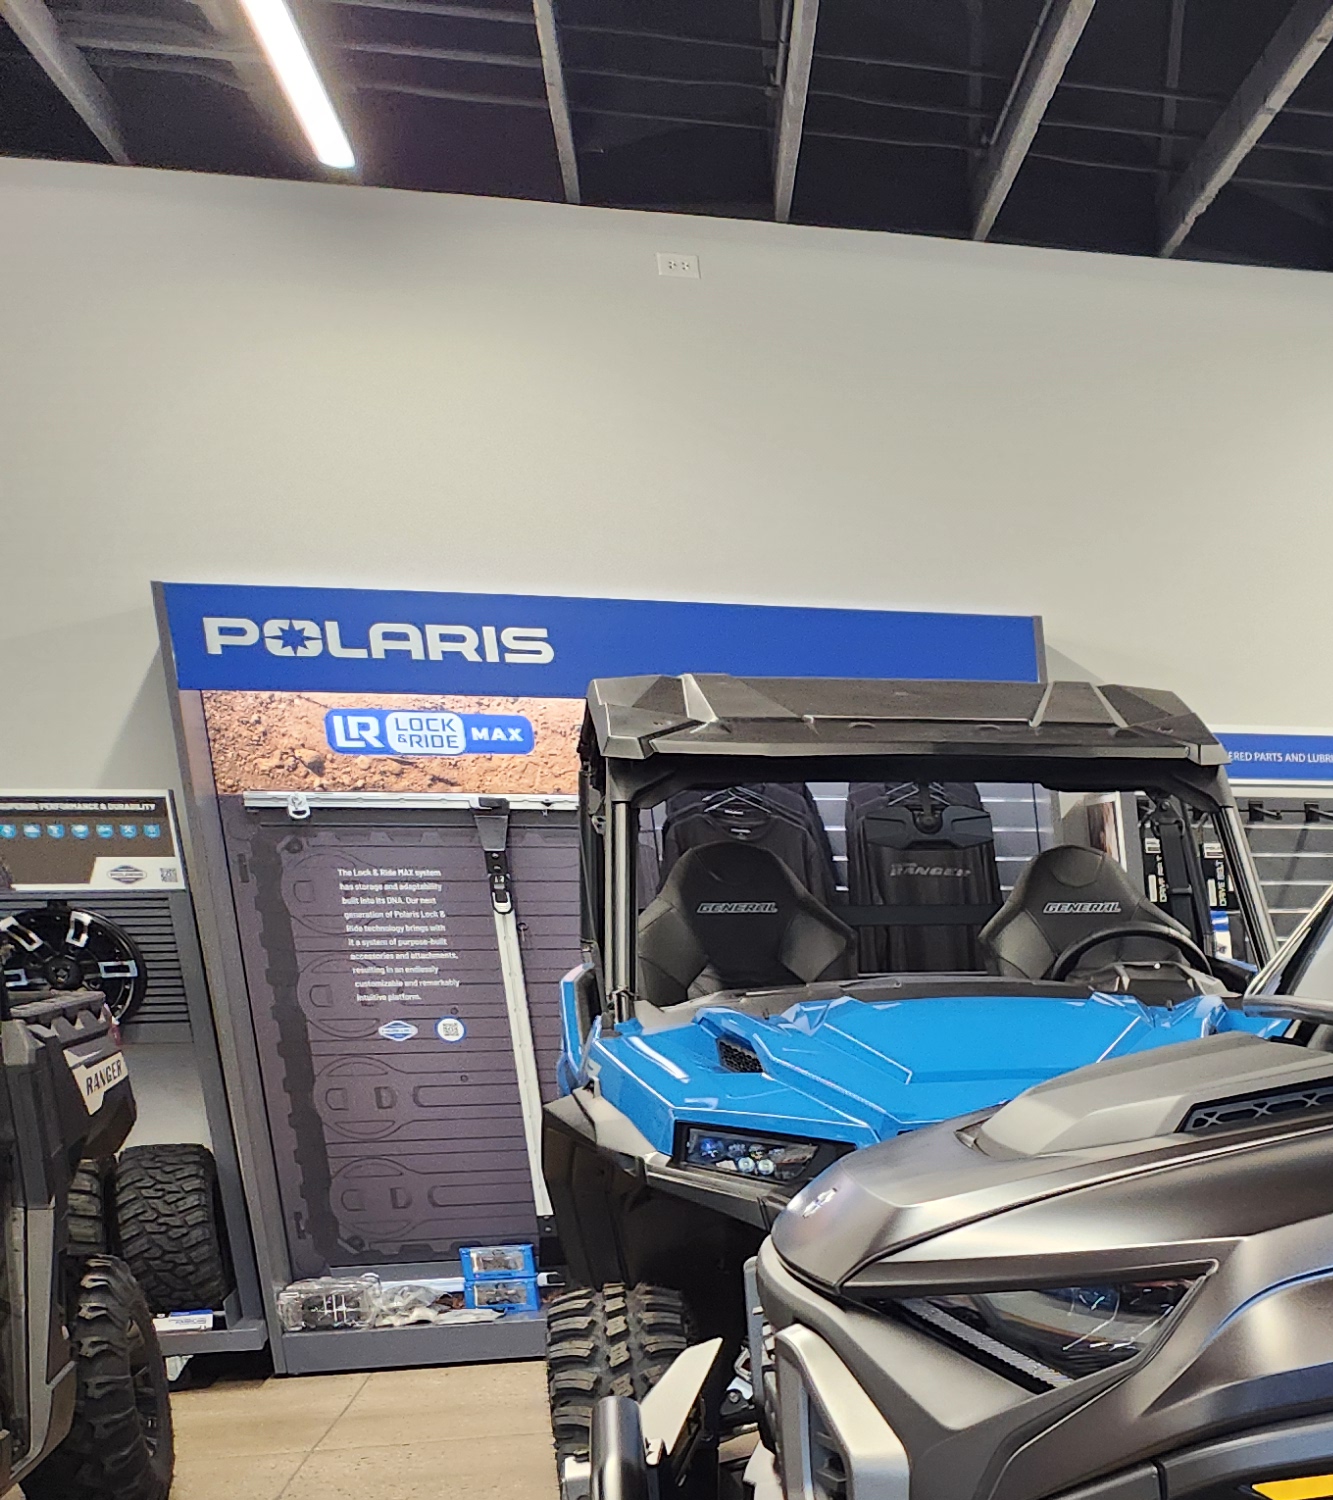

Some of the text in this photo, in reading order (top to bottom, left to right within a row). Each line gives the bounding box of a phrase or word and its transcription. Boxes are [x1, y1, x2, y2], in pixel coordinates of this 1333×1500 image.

[202, 617, 555, 665] POLARIS
[395, 717, 456, 732] LOCK
[471, 727, 524, 742] MAX
[1254, 752, 1283, 763] PARTS
[1285, 753, 1306, 763] AND
[337, 868, 352, 877] The
[353, 868, 371, 877] Lock
[398, 868, 414, 877] MAX
[697, 902, 779, 914] GENERAL
[1043, 902, 1122, 914] GENERAL
[85, 1059, 123, 1097] RANGER
